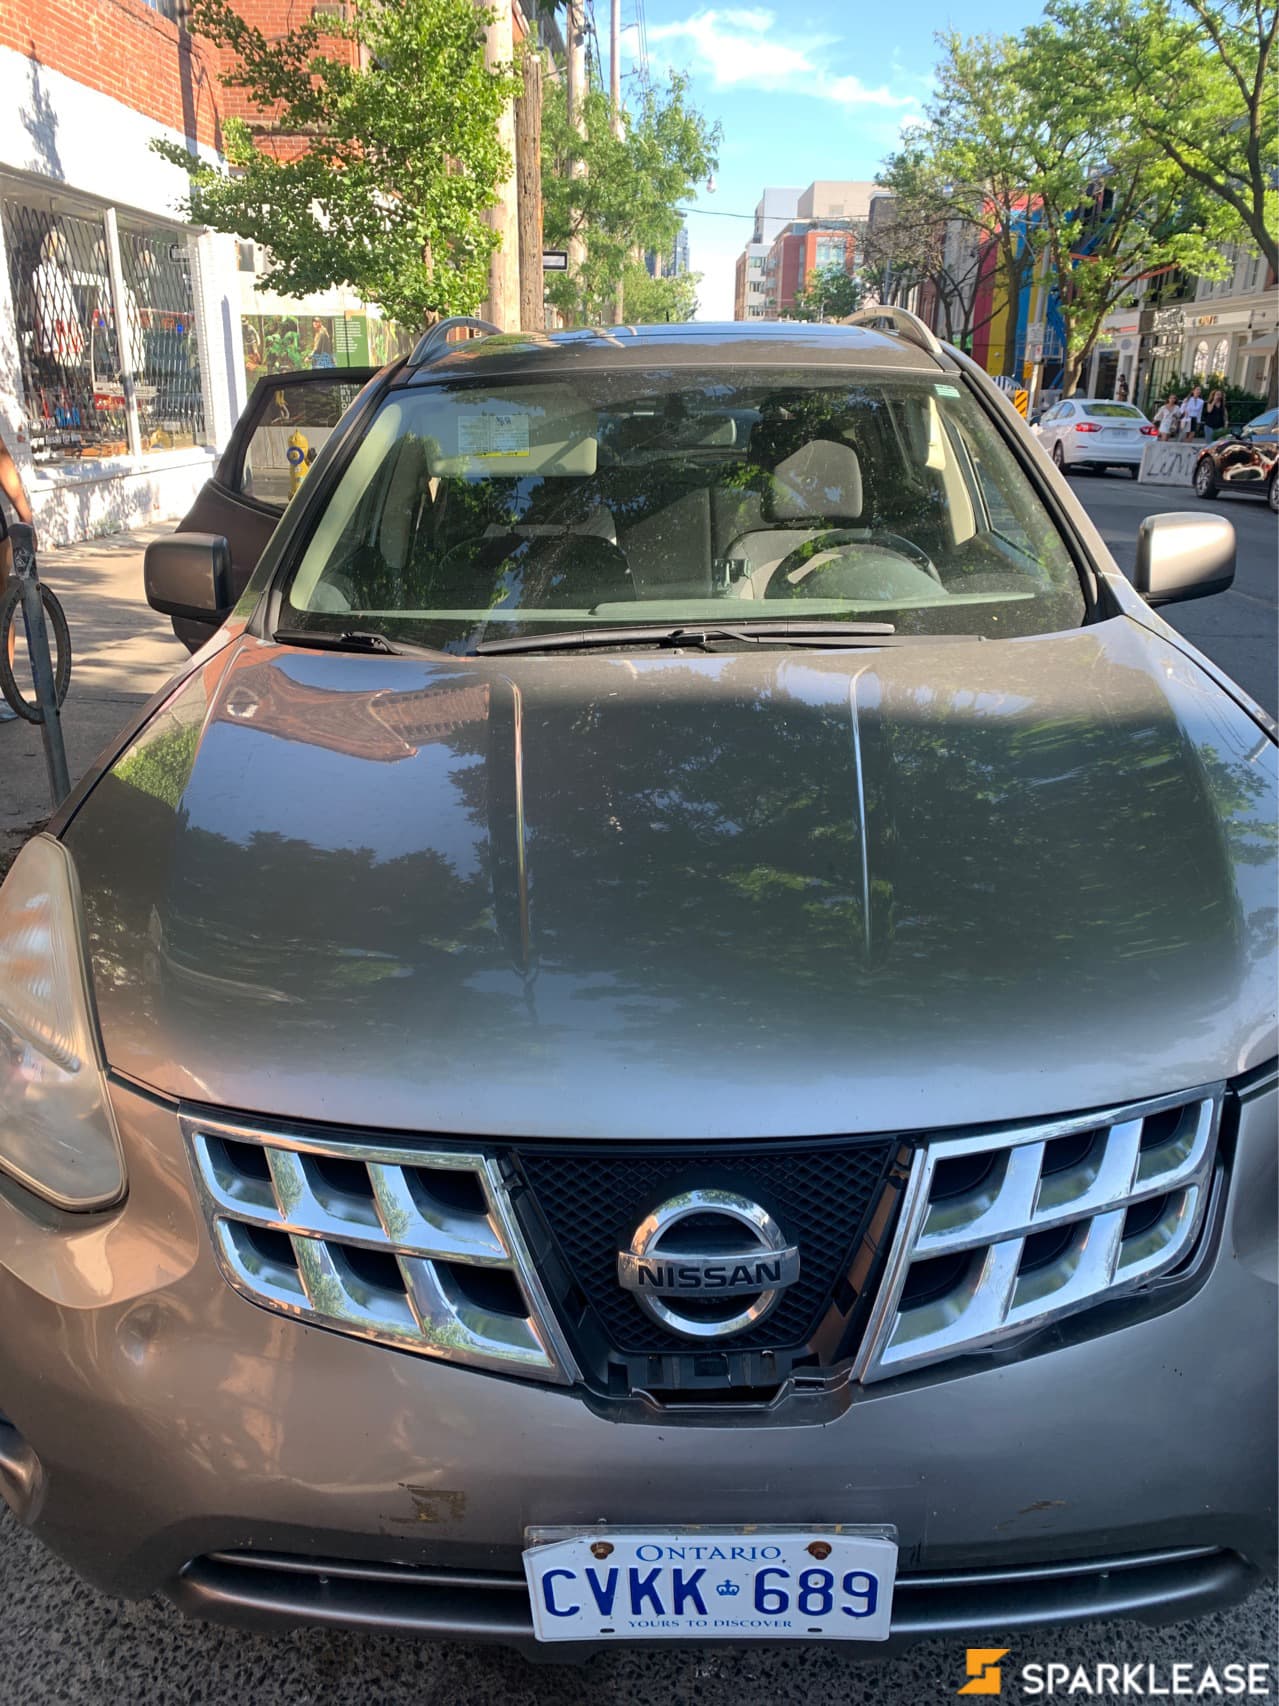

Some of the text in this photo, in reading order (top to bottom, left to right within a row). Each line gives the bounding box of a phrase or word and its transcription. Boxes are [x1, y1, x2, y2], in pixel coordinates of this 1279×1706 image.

[638, 1260, 781, 1289] NISSAN
[635, 1544, 782, 1562] ONTARIO
[541, 1567, 879, 1617] CVKK 689
[628, 1619, 792, 1629] YOURS TO DISCOVER
